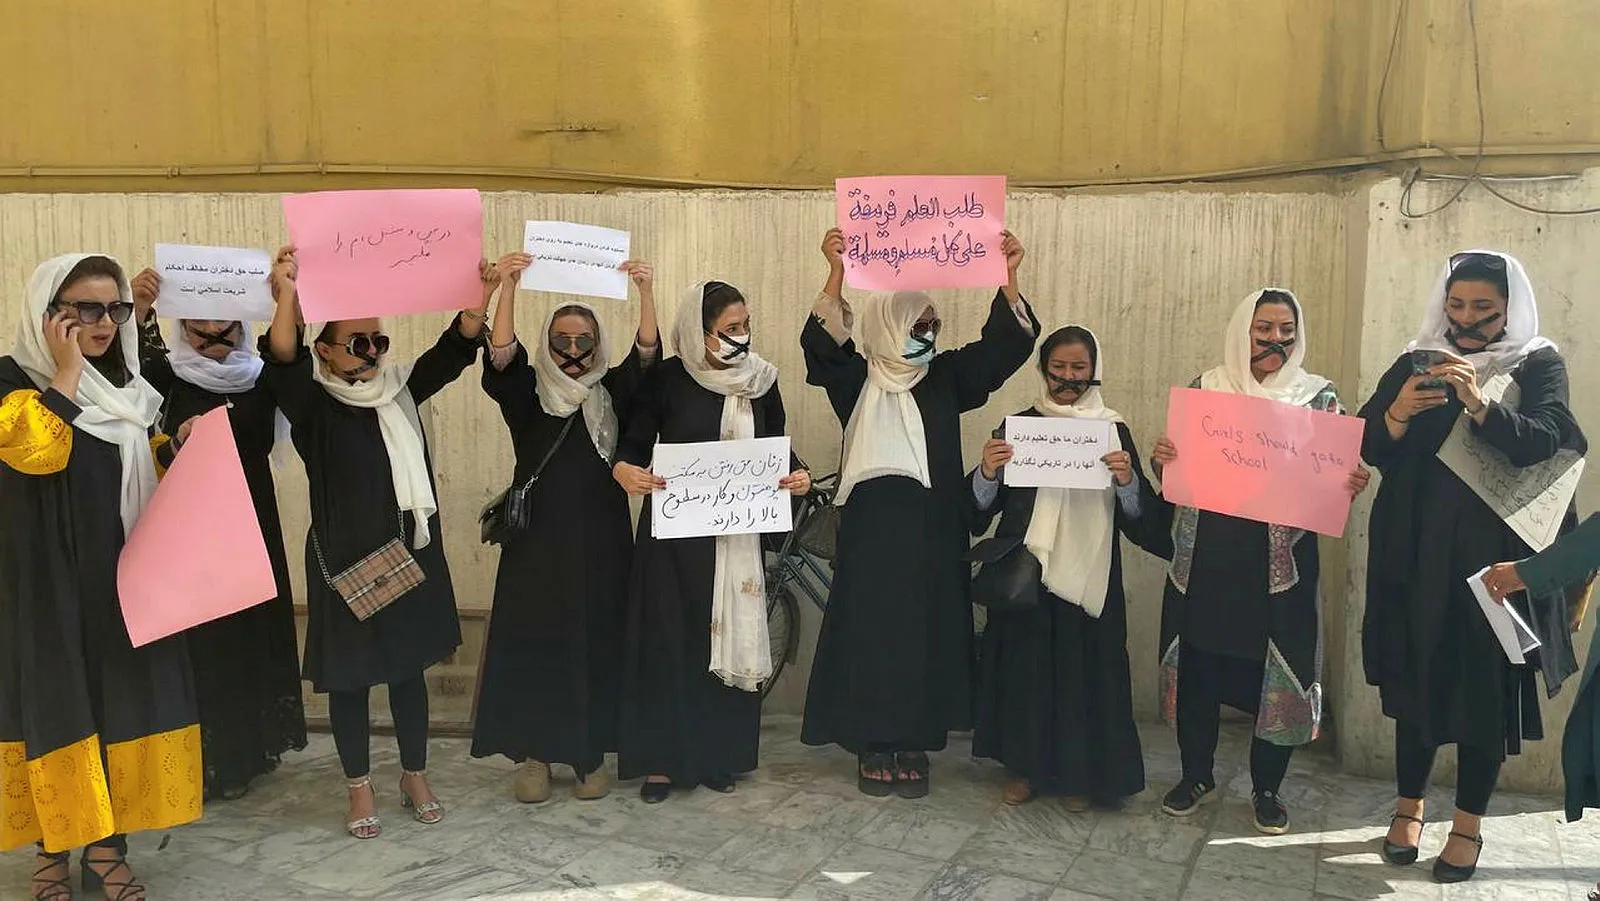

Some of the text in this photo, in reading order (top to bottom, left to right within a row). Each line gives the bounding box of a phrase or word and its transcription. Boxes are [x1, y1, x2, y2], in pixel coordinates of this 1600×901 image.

[900, 194, 940, 227] العلم
[943, 192, 984, 228] طلب
[164, 263, 184, 271] احکام
[186, 263, 208, 272] مخالف
[210, 264, 233, 274] دختران
[235, 267, 246, 276] حق
[180, 284, 195, 293] است
[223, 286, 246, 295] شریعت
[1013, 433, 1029, 443] دارند
[1031, 434, 1047, 444] تعلیم
[1049, 436, 1061, 444] حق
[1073, 435, 1098, 445] دختران
[708, 460, 734, 479] رفتن
[751, 453, 783, 477] زنان
[1063, 461, 1071, 469] در
[1073, 460, 1080, 469] را
[663, 458, 700, 484] مکتب
[712, 479, 732, 507] کار
[662, 488, 700, 519] سطوح
[700, 493, 711, 504] در
[726, 493, 735, 505] و
[746, 507, 755, 528] را
[762, 506, 778, 525] بالا
